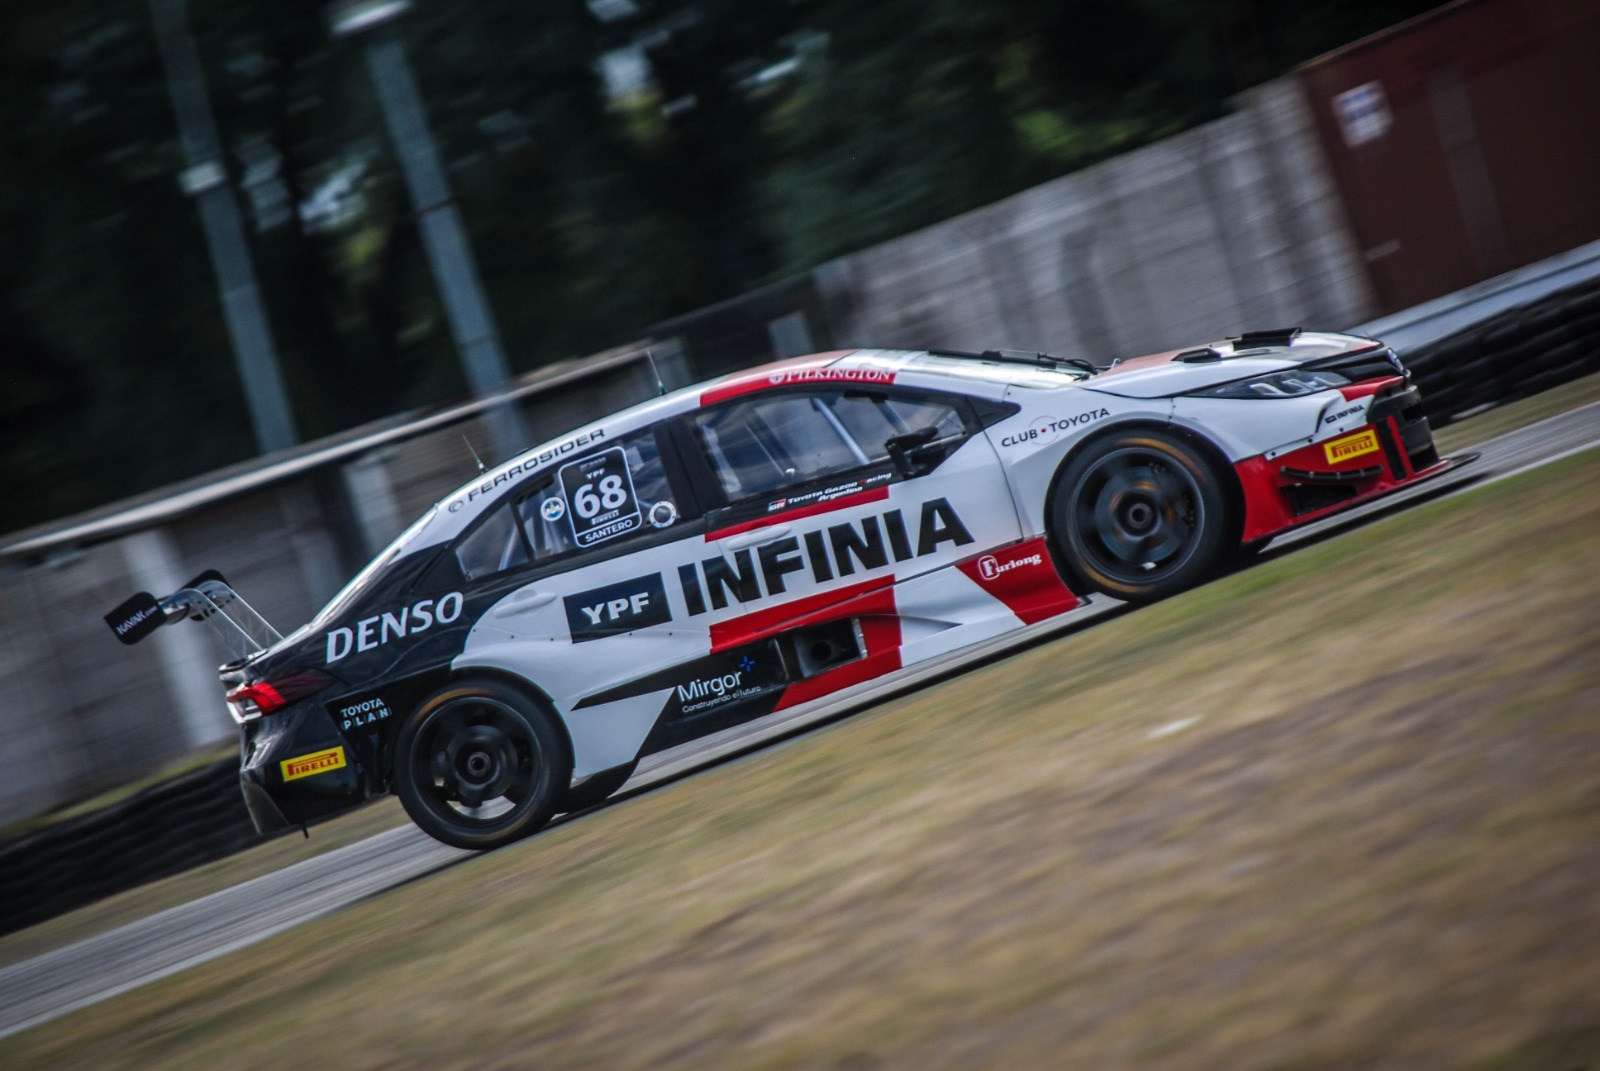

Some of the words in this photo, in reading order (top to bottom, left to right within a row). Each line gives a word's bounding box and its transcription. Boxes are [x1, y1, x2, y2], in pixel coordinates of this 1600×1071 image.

[786, 367, 891, 381] PILKINGTON
[1001, 428, 1038, 447] CLUB
[1048, 407, 1110, 432] TOYOTA
[1330, 435, 1374, 458] PIRELLI
[468, 428, 605, 502] FERROSIDER
[586, 467, 605, 480] YPF
[574, 474, 627, 519] 68
[787, 489, 823, 504] TOYOTA
[818, 486, 863, 502] Argentina
[585, 518, 633, 543] SANTERO
[677, 496, 976, 617] INFINIA
[981, 554, 1042, 577] Furlong
[581, 591, 650, 626] YPF
[326, 591, 464, 664] DENSO
[677, 671, 742, 703] Mirgor
[340, 698, 385, 718] TOYOTA
[682, 694, 732, 713] Construyendo
[287, 752, 340, 777] PIRELLI
